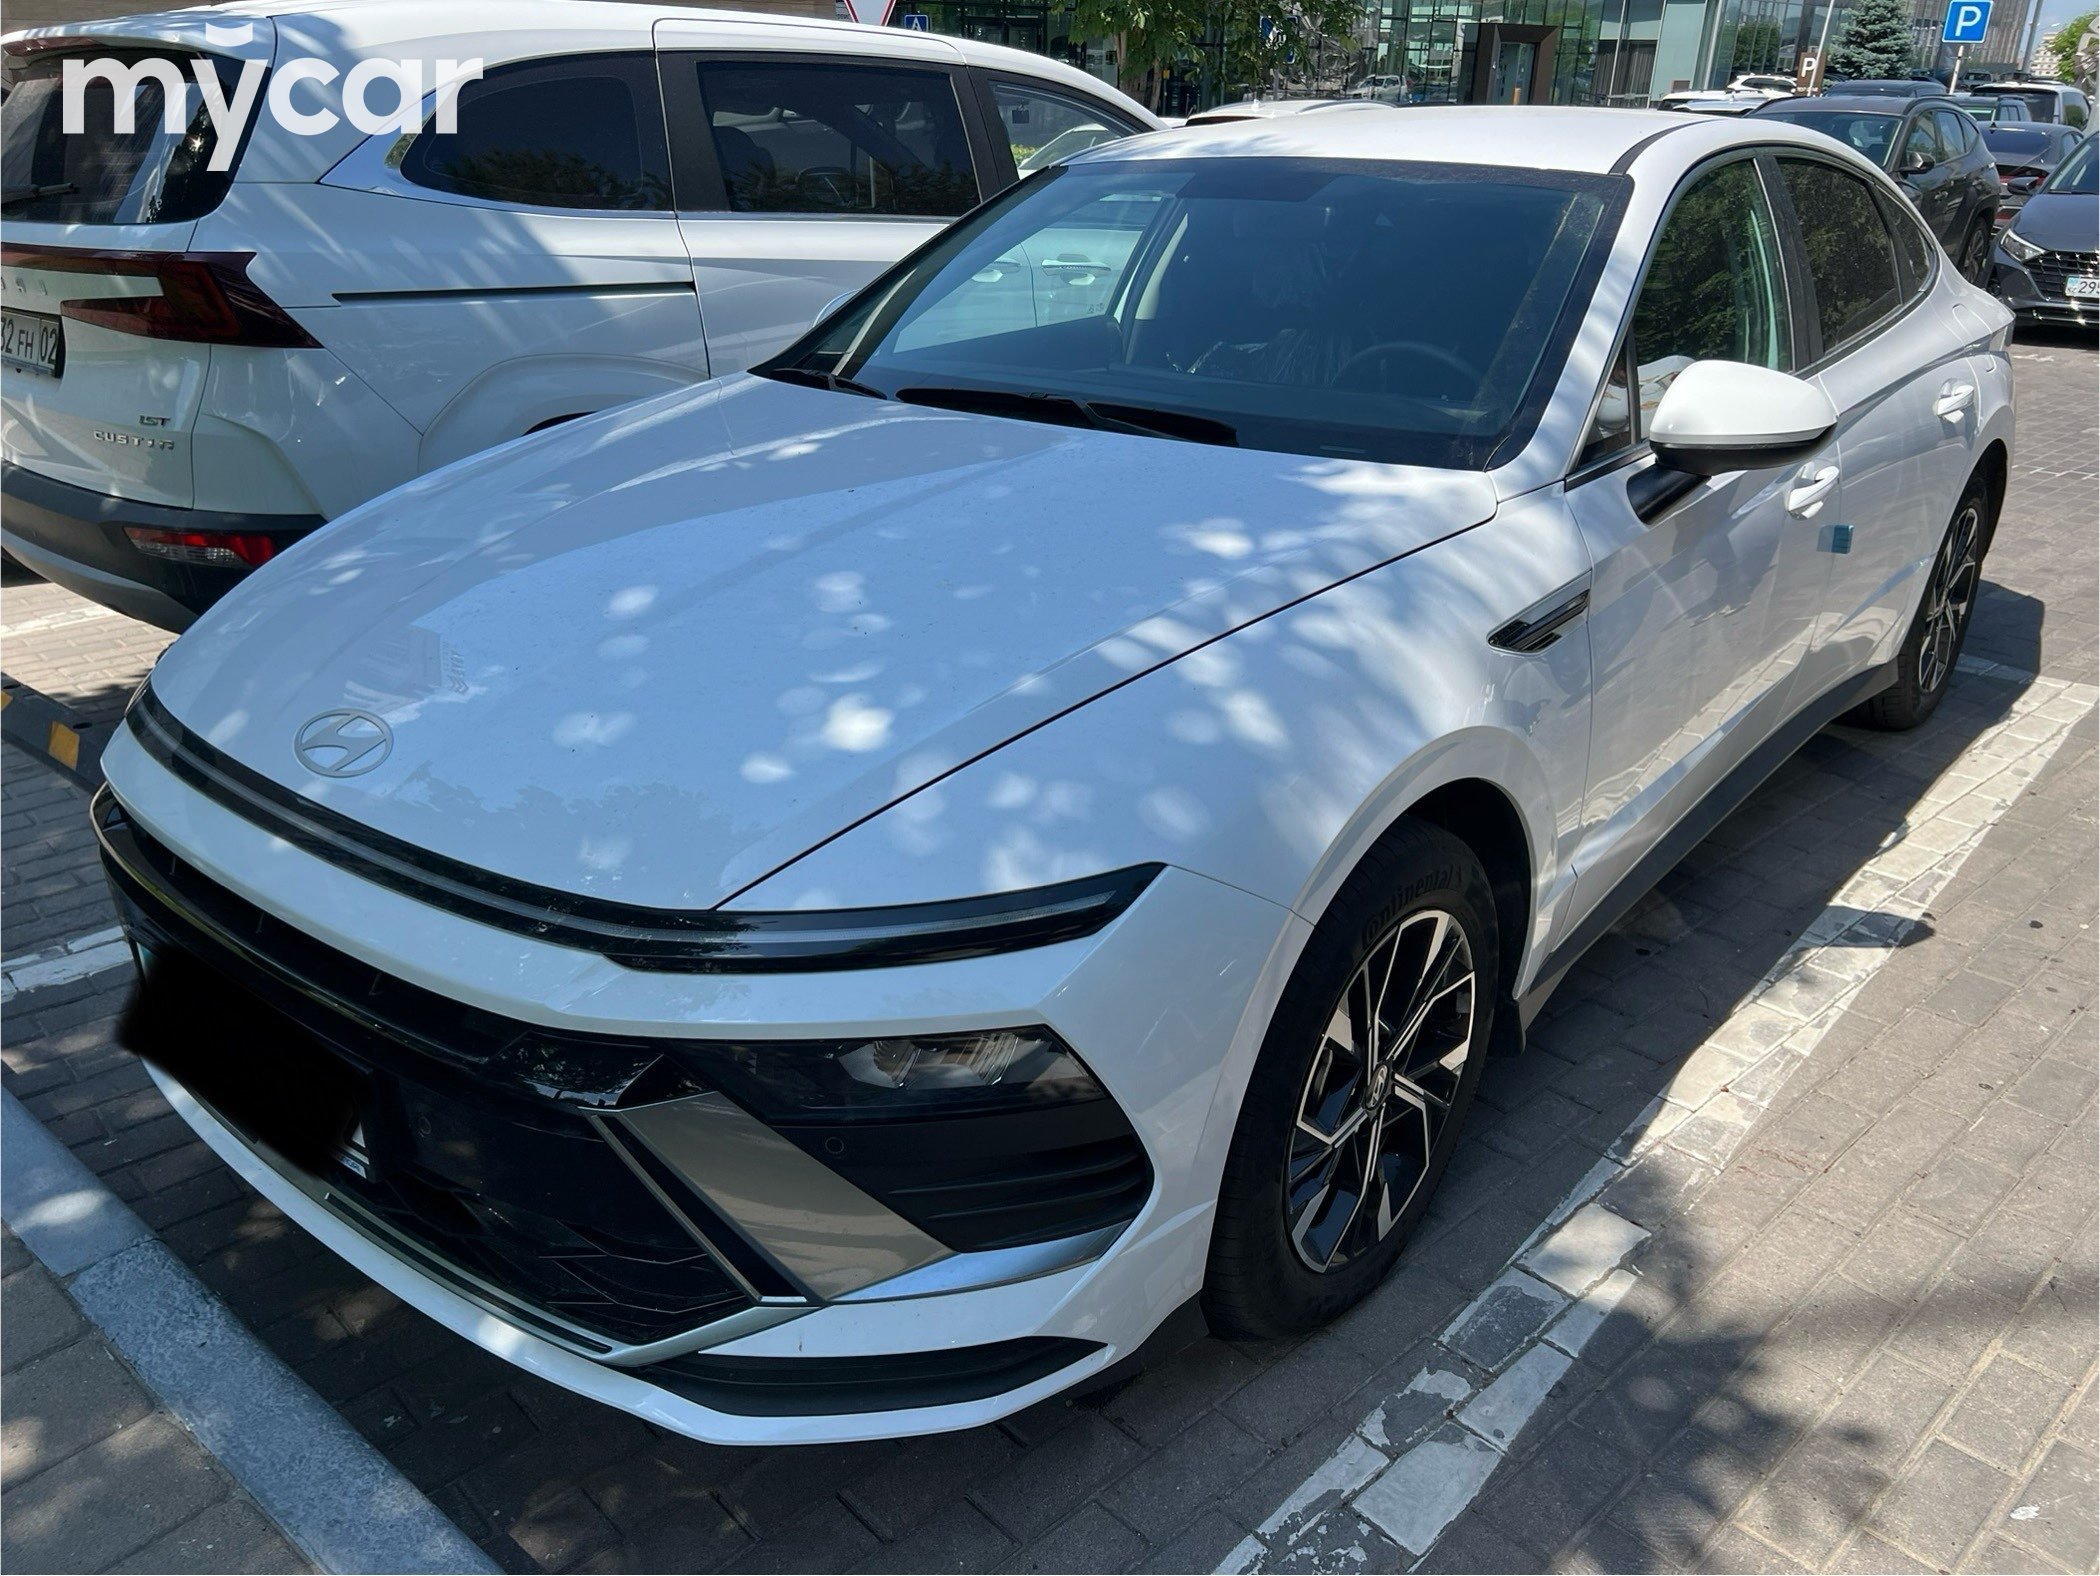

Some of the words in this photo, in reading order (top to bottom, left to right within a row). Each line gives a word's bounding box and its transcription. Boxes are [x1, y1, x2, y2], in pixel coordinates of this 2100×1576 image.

[1955, 6, 1981, 36] P
[1801, 58, 1817, 77] P
[17, 329, 35, 359] FH
[40, 326, 59, 364] 02
[1362, 863, 1454, 948] Continental
